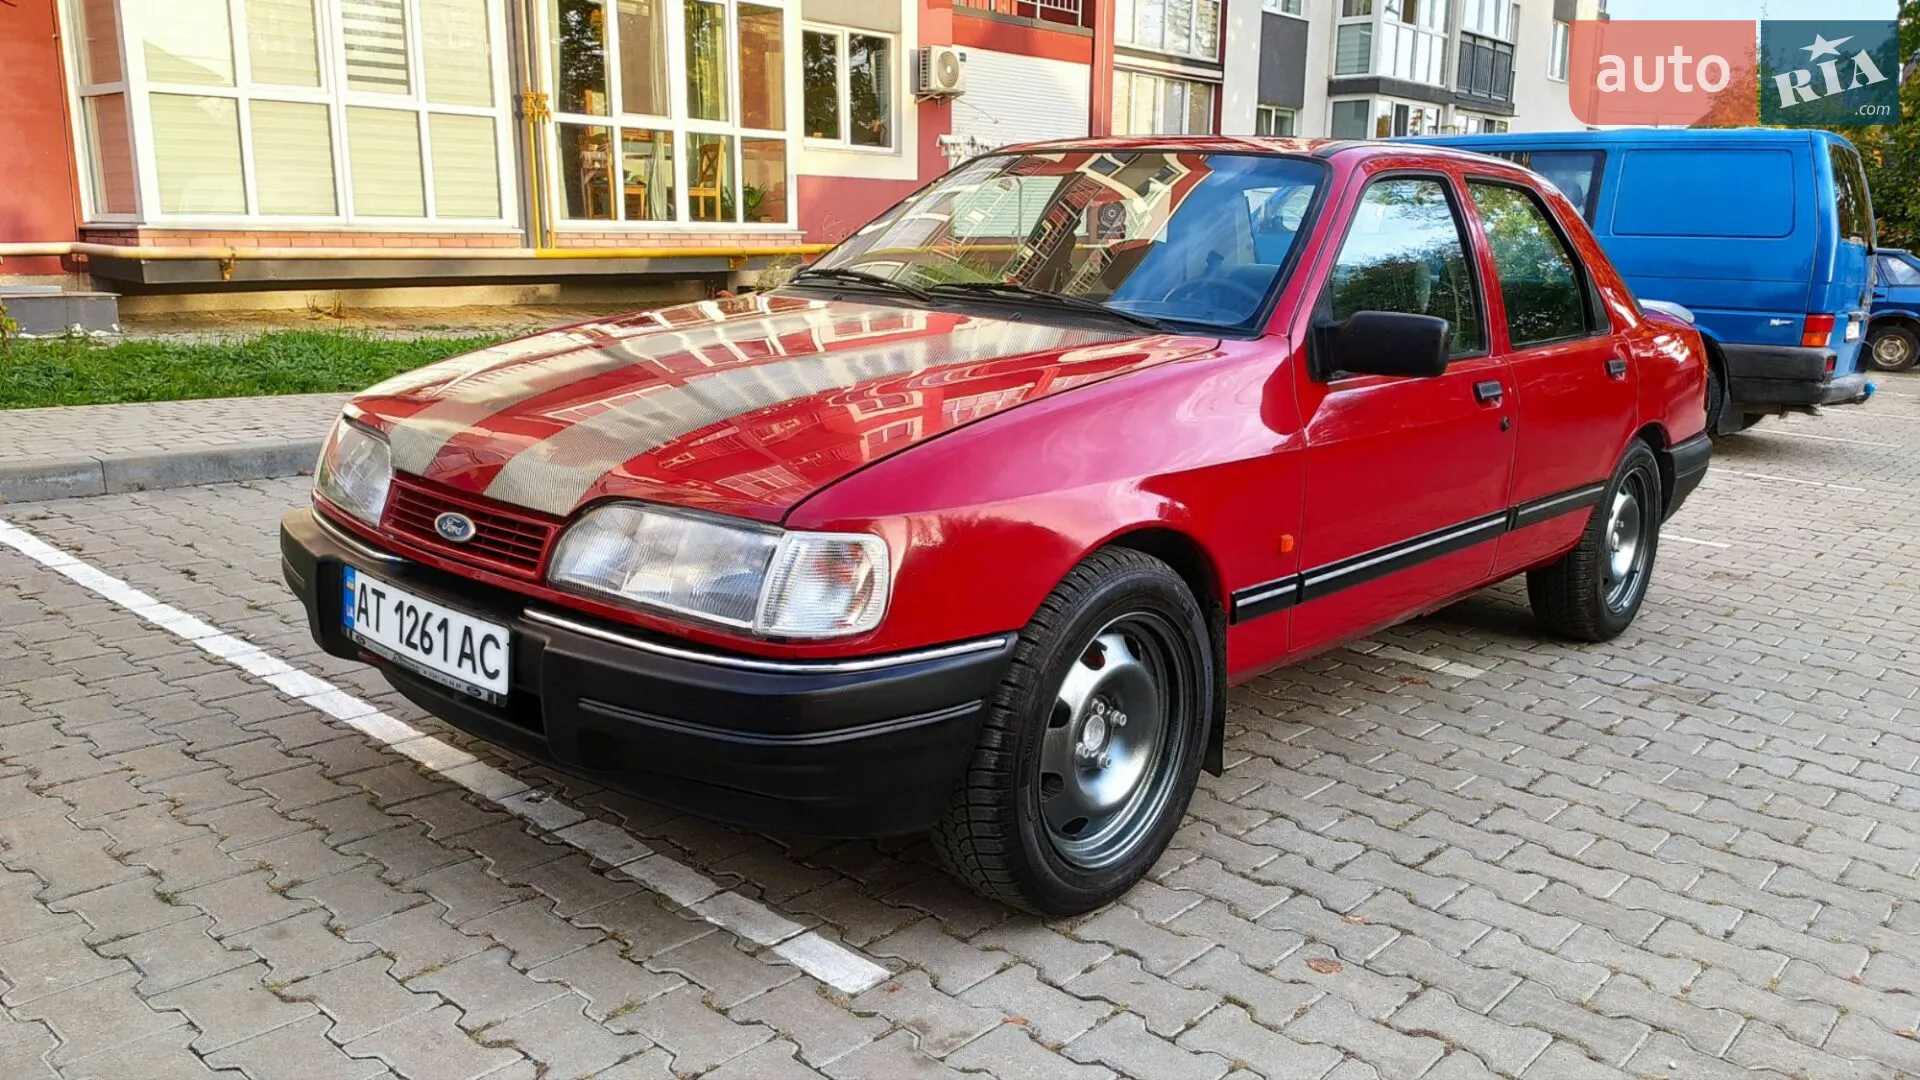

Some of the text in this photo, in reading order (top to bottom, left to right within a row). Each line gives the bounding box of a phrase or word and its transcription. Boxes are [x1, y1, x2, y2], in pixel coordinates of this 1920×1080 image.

[441, 516, 466, 536] Ford
[356, 582, 386, 633] AT
[394, 599, 449, 663] 1261
[457, 625, 502, 680] AC
